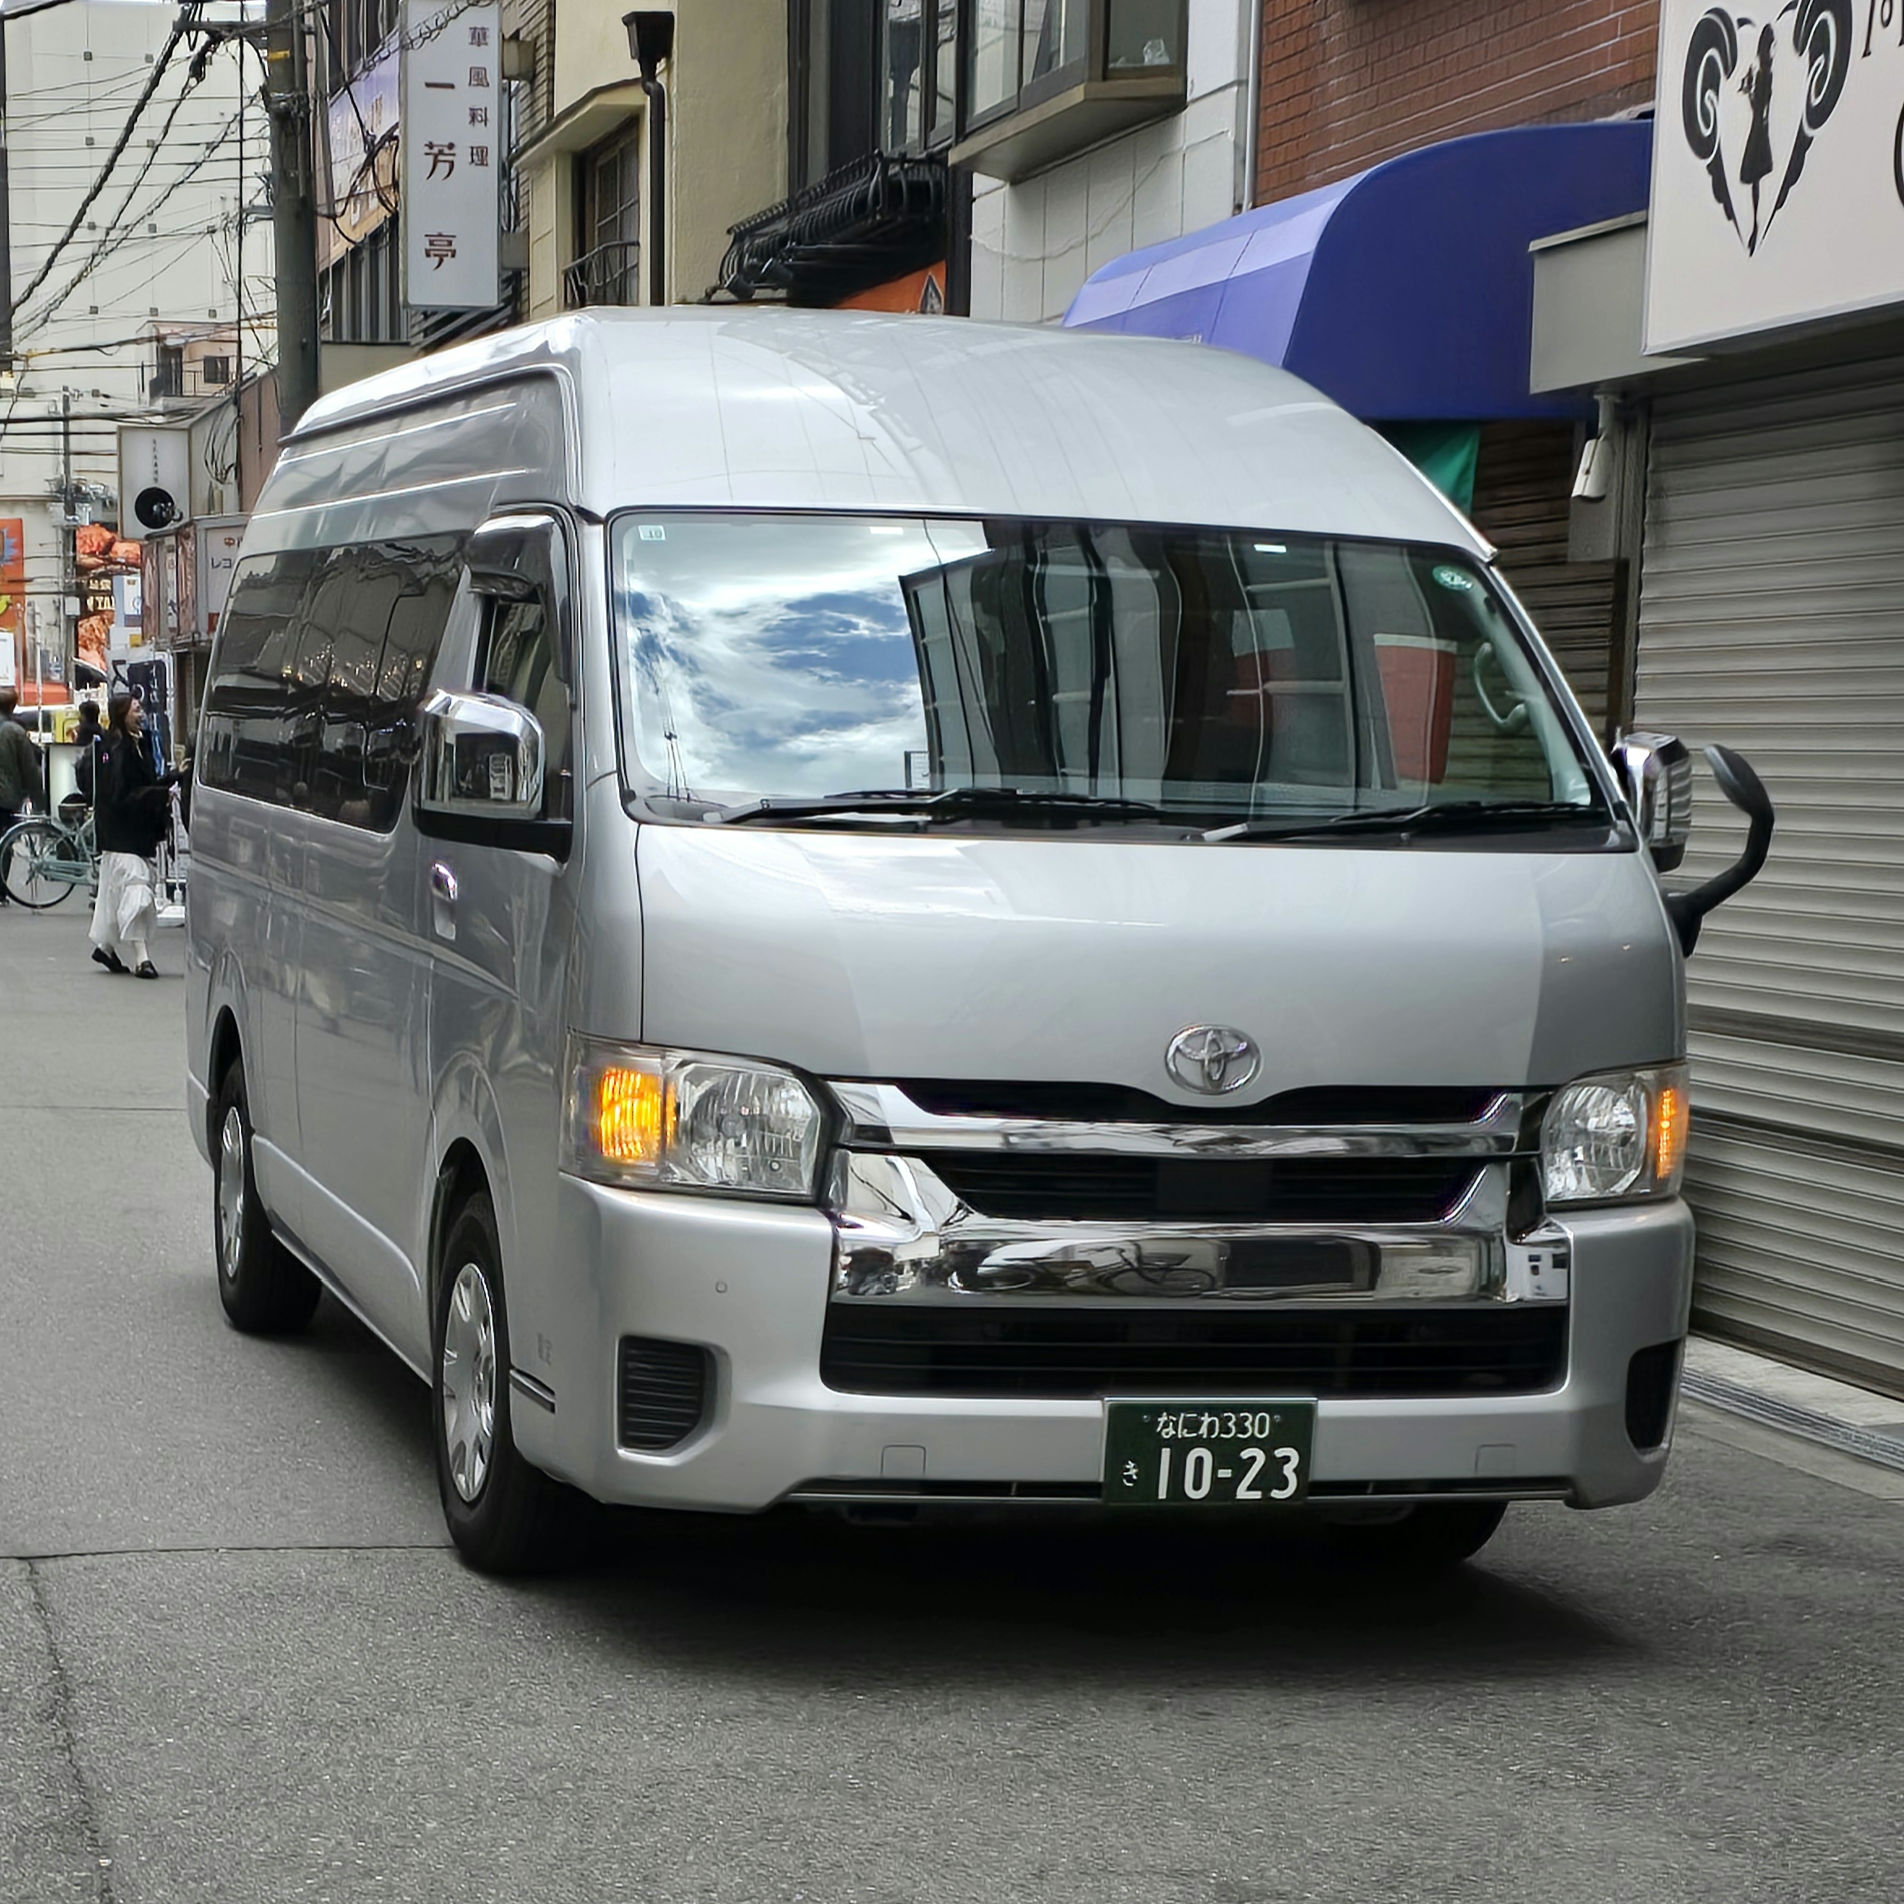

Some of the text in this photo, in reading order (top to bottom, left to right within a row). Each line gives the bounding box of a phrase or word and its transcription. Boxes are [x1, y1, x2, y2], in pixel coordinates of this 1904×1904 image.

[424, 81, 456, 271] 一芳亭
[1158, 1447, 1300, 1500] 10-23
